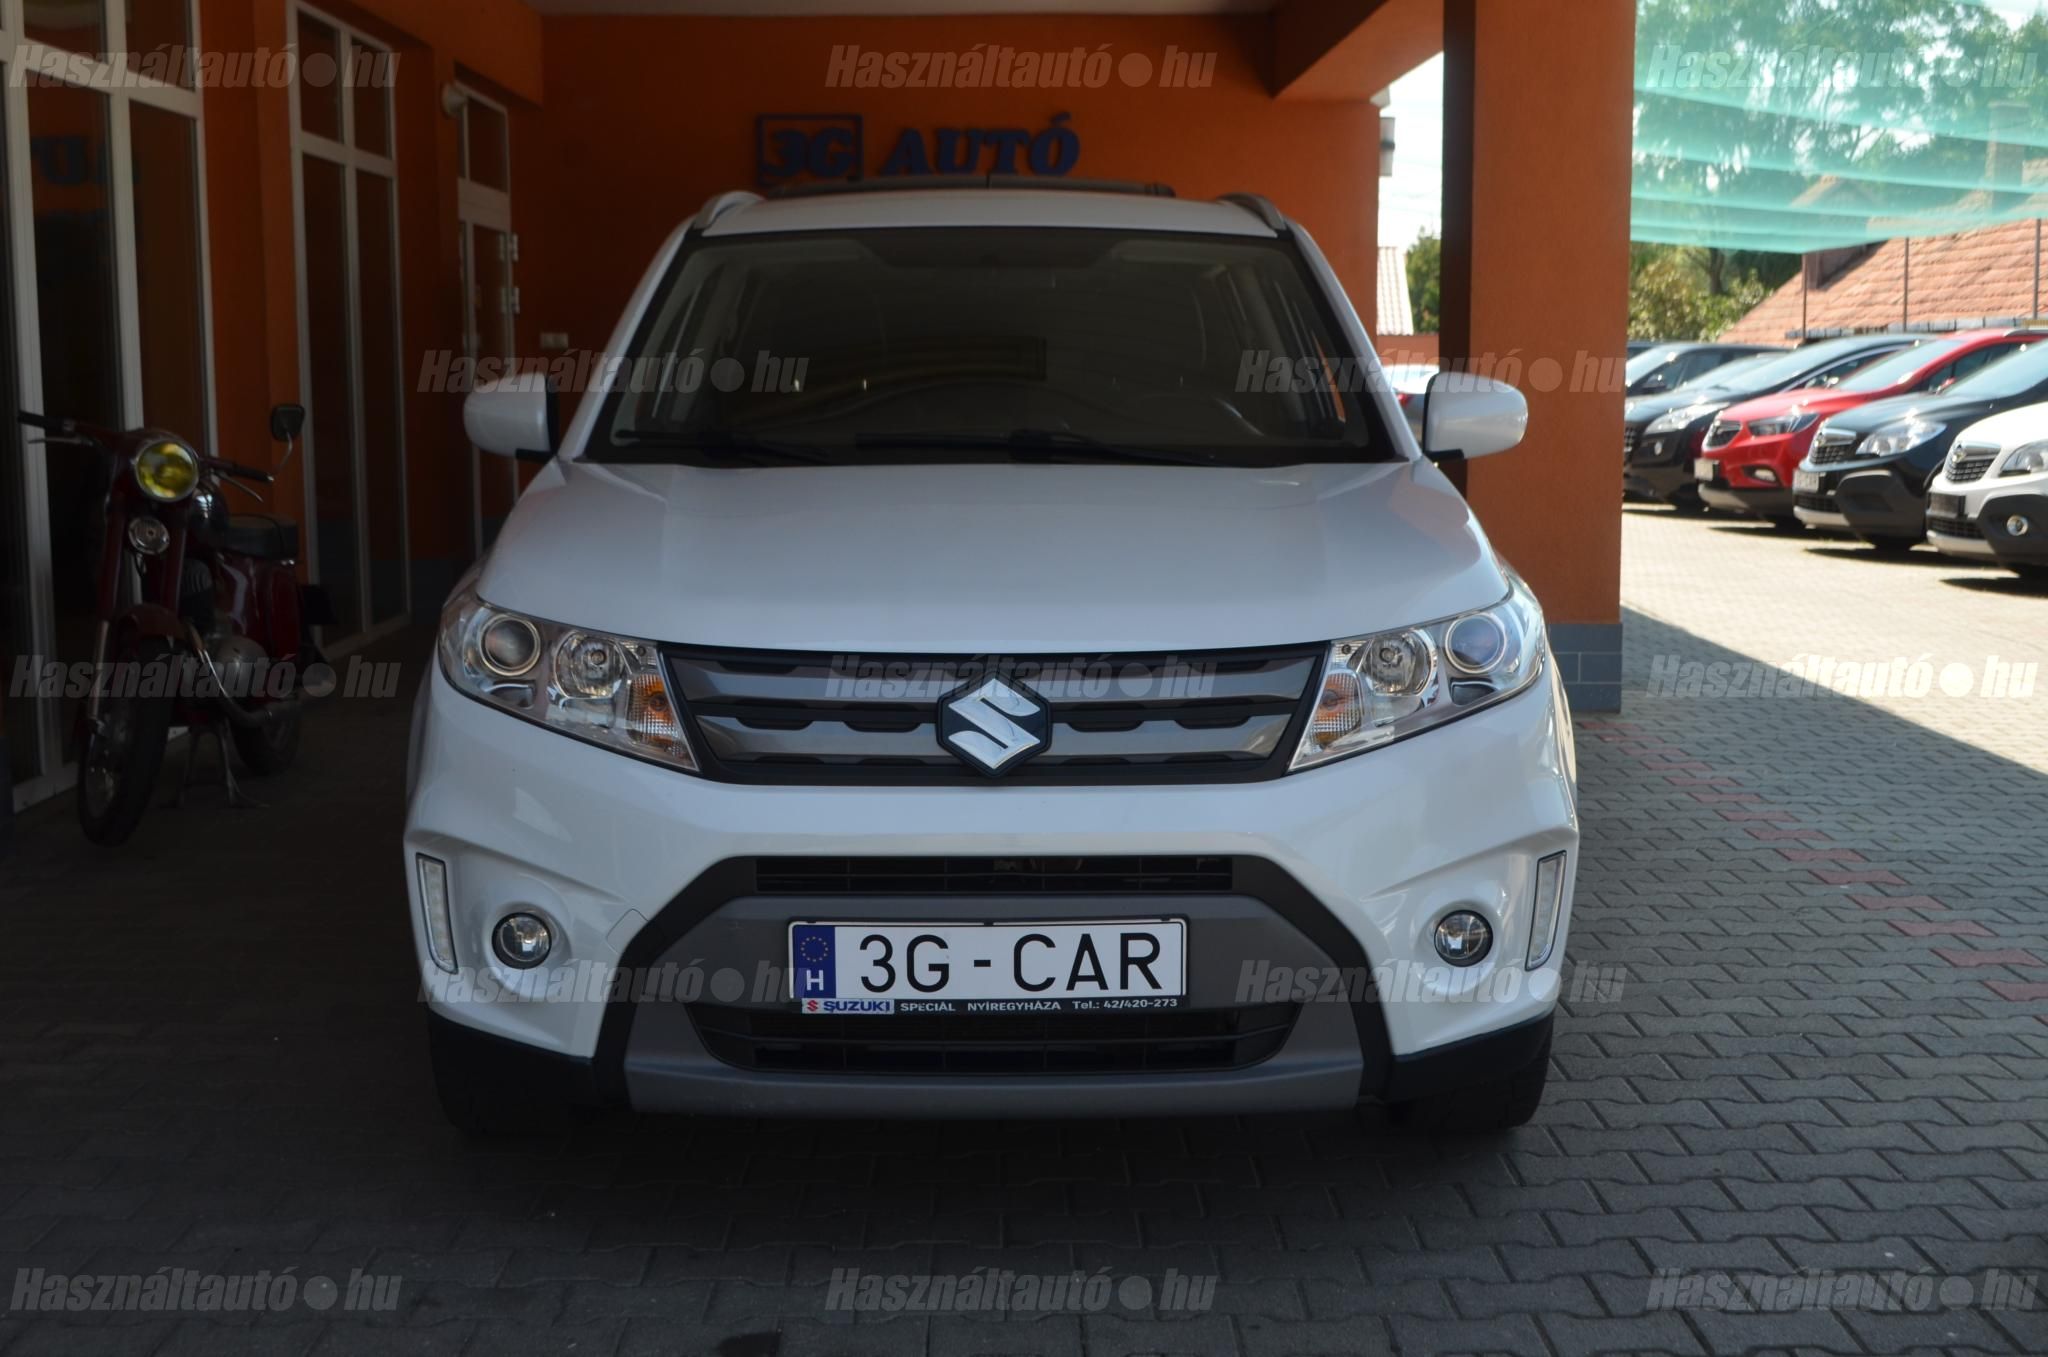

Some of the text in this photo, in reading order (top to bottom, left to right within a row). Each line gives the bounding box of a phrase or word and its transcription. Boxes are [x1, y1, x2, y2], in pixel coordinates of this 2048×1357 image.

[761, 111, 1080, 178] 3G AUTÓ
[806, 969, 825, 991] H
[823, 1000, 891, 1013] SUZUKI
[967, 1001, 1061, 1011] NYÍREGYHÁZA
[1103, 999, 1178, 1009] 42/420-273
